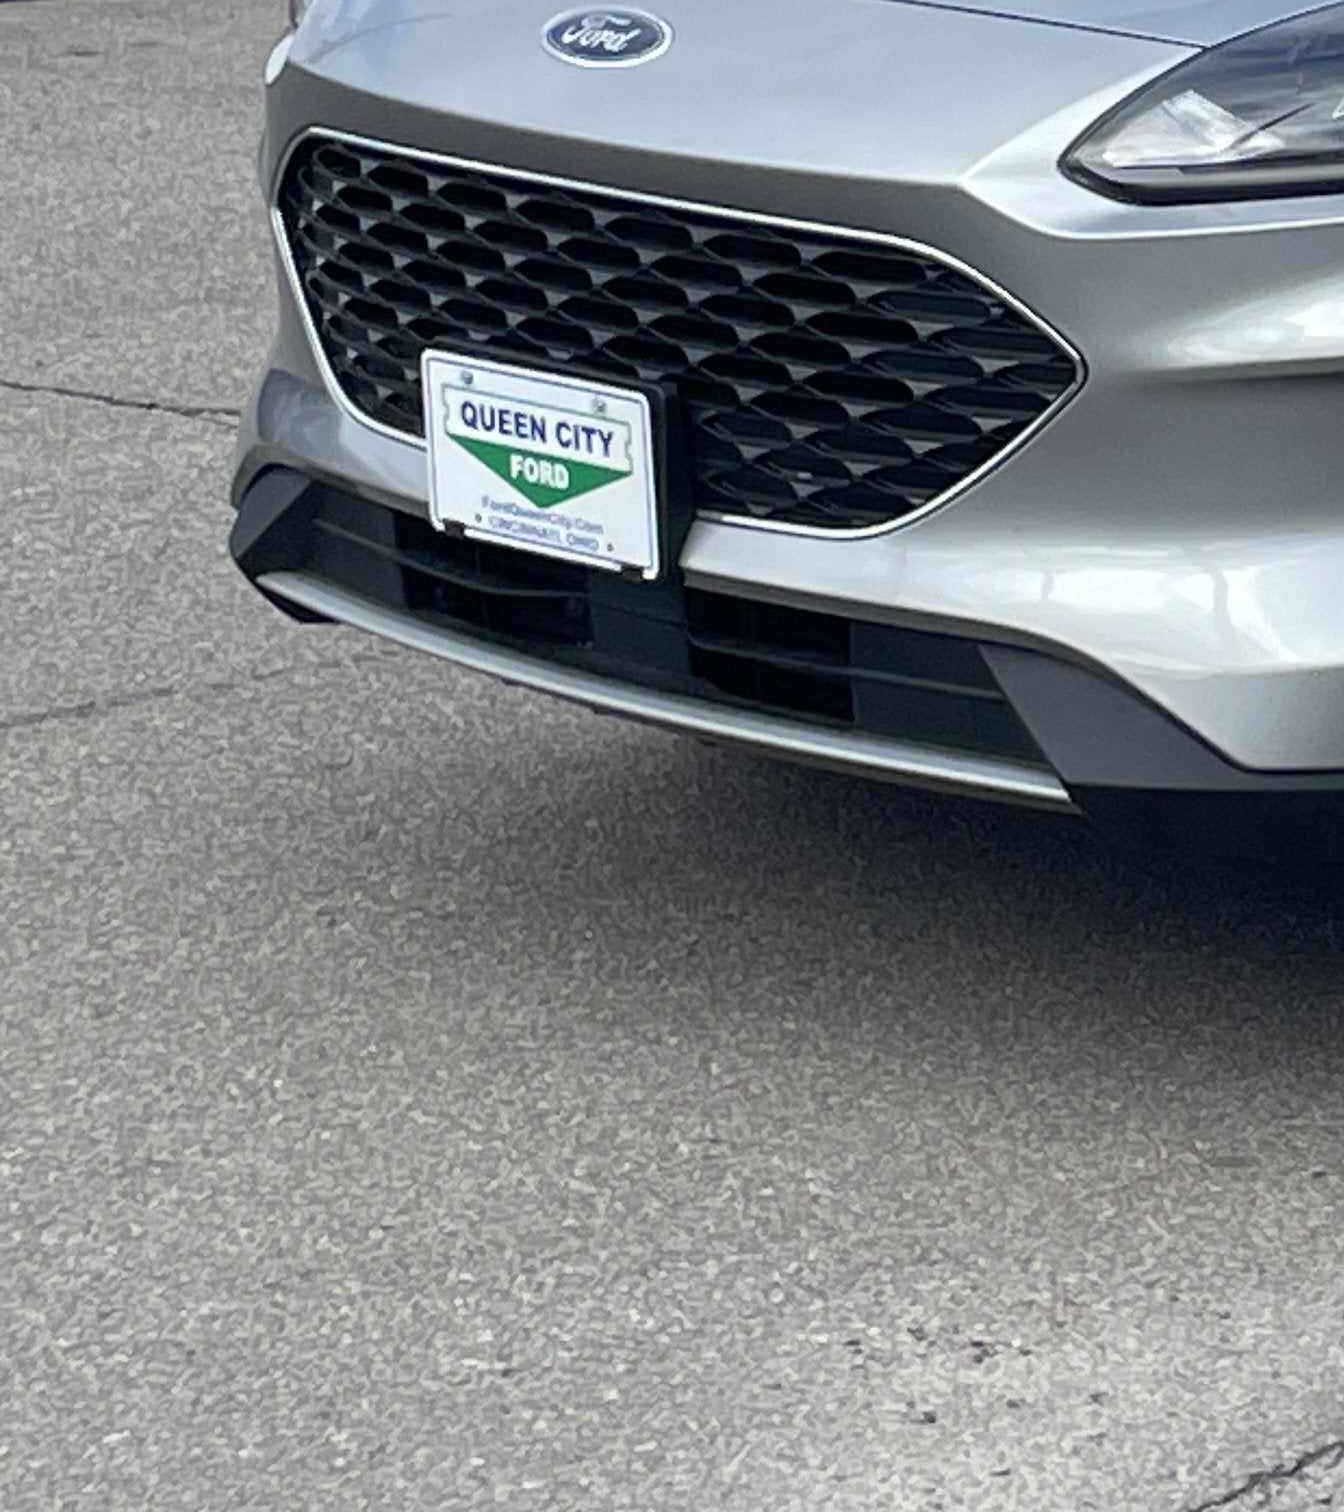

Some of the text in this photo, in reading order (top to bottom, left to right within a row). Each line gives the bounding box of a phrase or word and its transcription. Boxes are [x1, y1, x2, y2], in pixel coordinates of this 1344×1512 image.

[561, 13, 641, 53] Ford
[461, 401, 614, 457] QUEEN CITY
[510, 454, 570, 489] FORD
